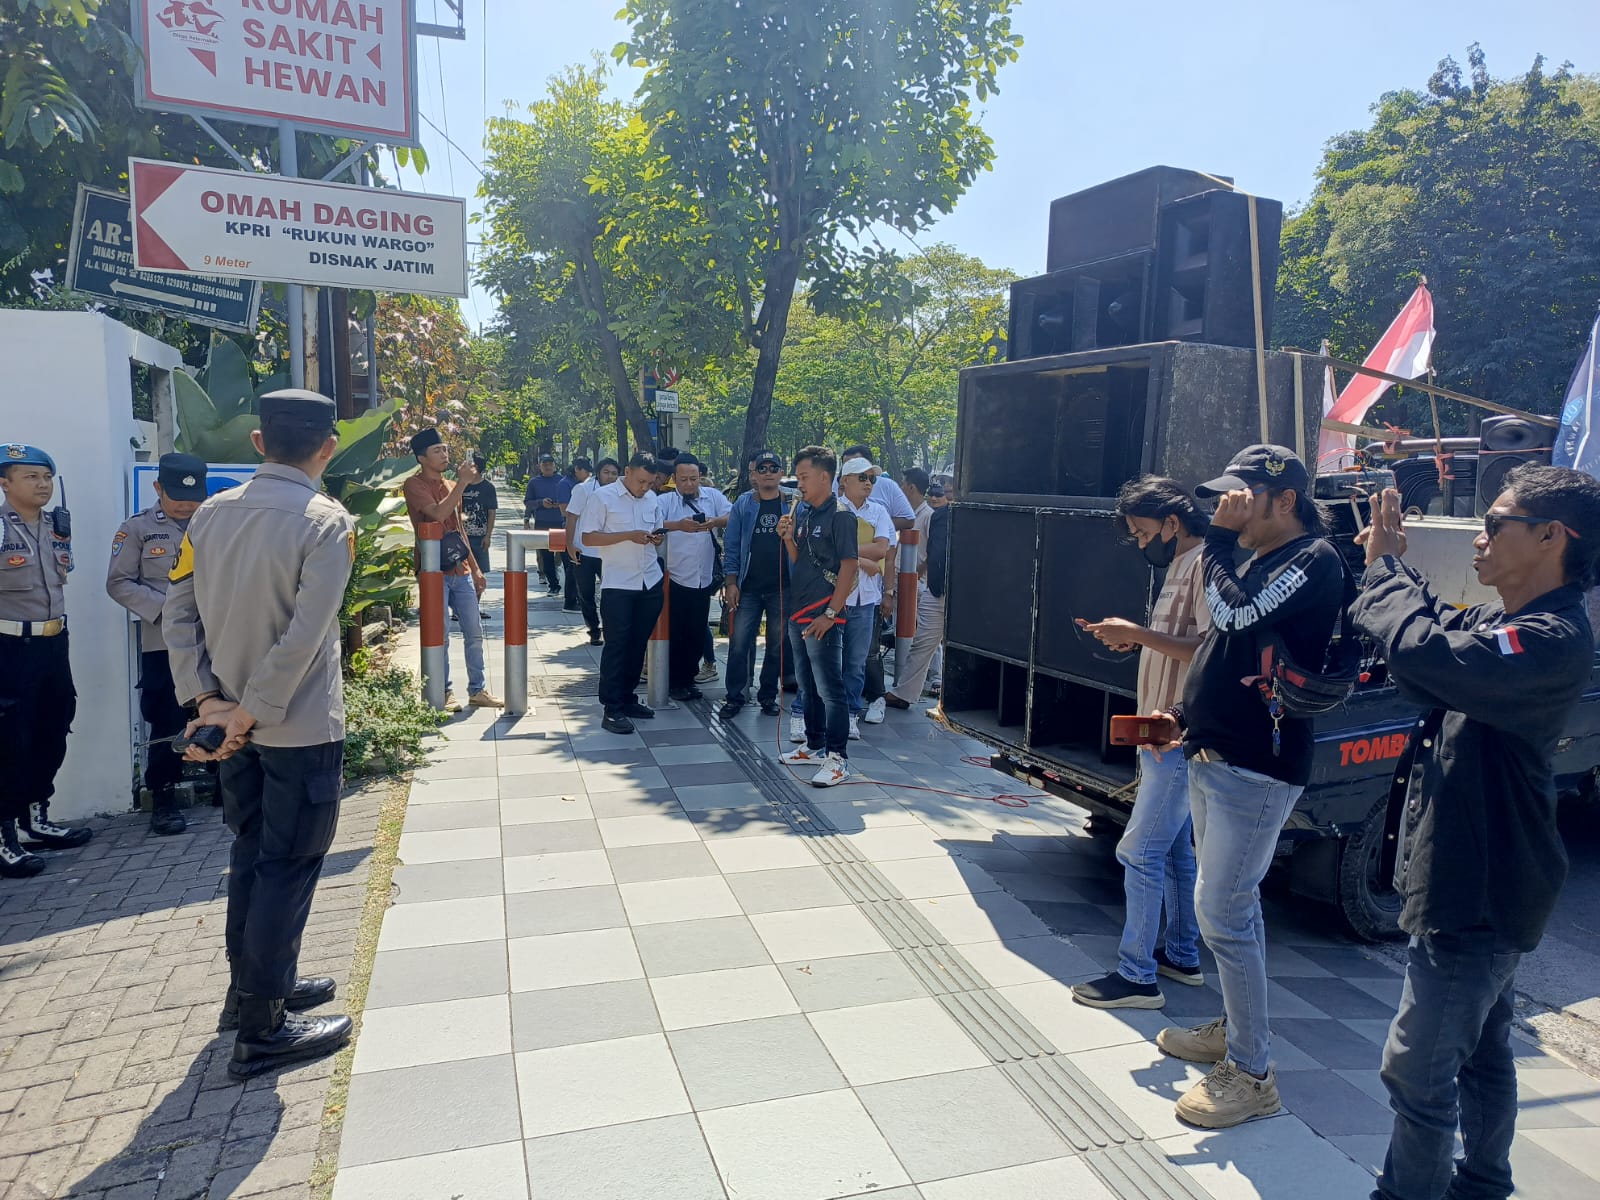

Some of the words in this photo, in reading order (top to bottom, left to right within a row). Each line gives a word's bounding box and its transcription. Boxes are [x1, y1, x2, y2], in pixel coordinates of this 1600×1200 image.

[242, 18, 357, 65] SAKIT
[244, 56, 387, 107] HEWAN
[200, 190, 302, 222] OMAH
[313, 202, 435, 236] DAGING
[92, 245, 116, 260] DINAS
[225, 221, 271, 238] KPRI
[282, 226, 357, 246] “RUKUN
[361, 234, 435, 253] WARGO”
[203, 254, 211, 265] 9
[215, 255, 253, 269] Meter
[309, 251, 378, 270] DISNAK
[382, 259, 434, 275] JATIM
[101, 261, 116, 274] YANI
[214, 286, 244, 303] SURABAYA
[1252, 564, 1309, 617] FREEDOM
[1234, 602, 1260, 631] FOR
[1338, 732, 1408, 768] TOMB
